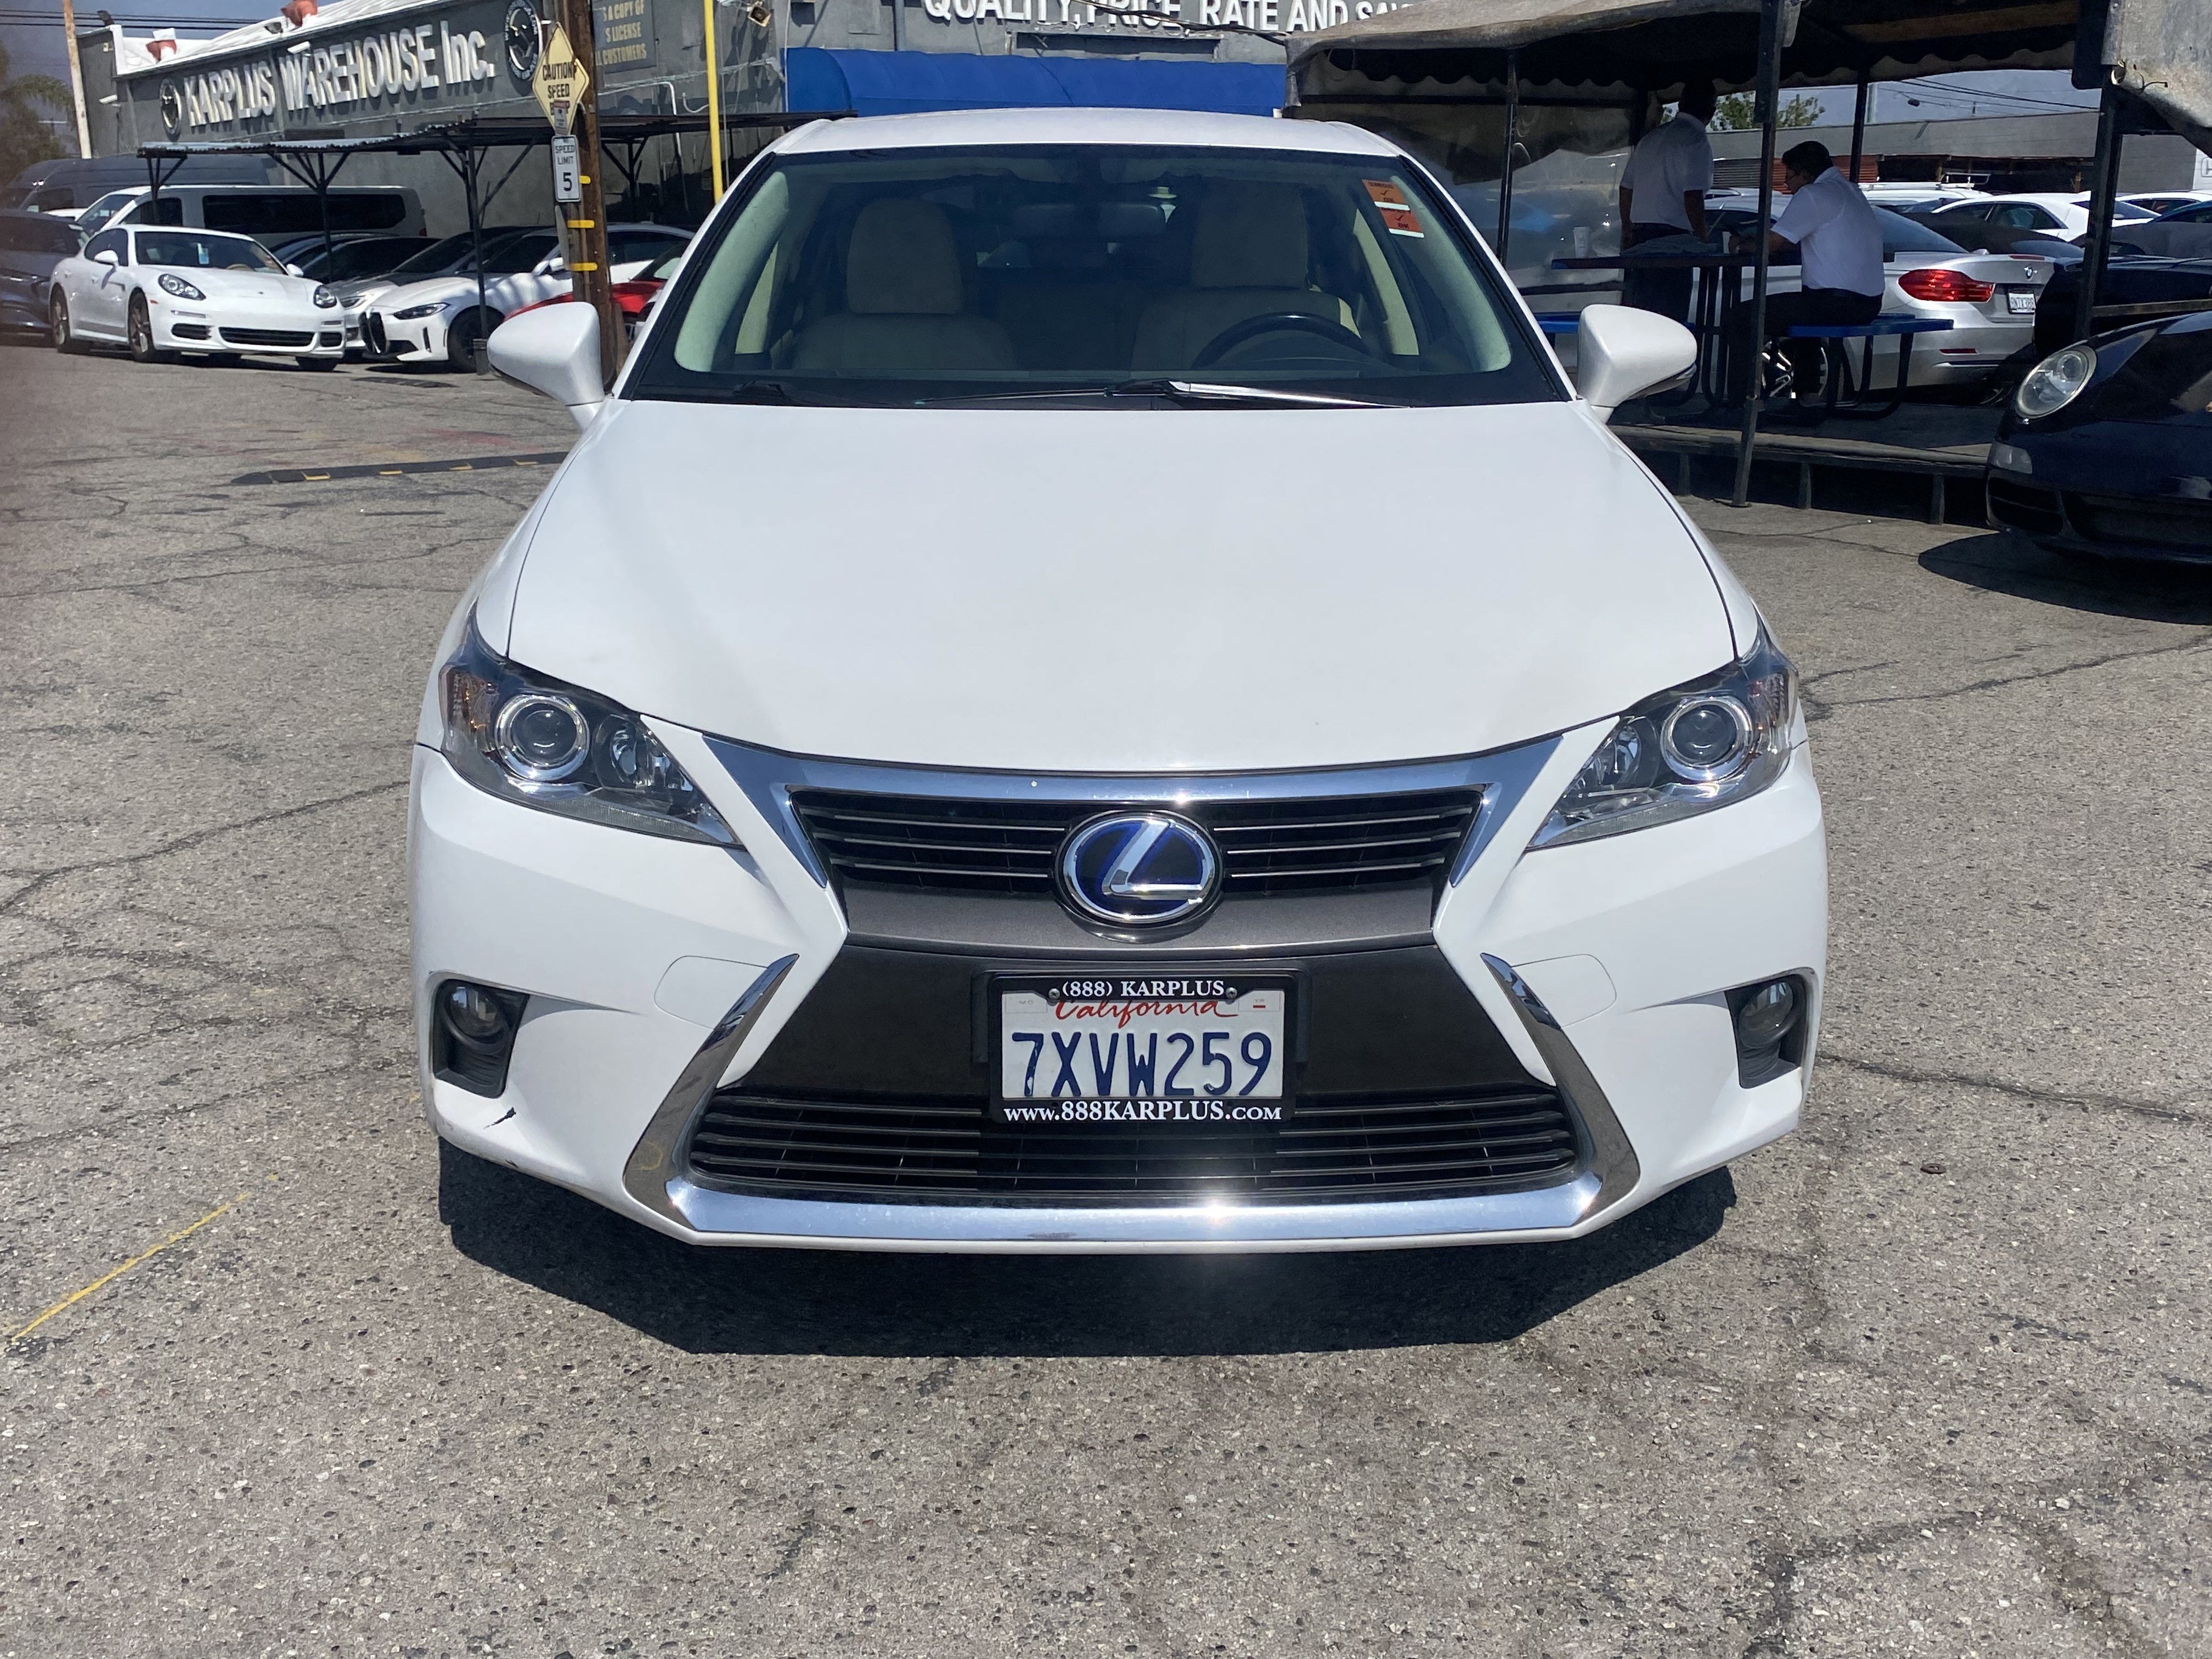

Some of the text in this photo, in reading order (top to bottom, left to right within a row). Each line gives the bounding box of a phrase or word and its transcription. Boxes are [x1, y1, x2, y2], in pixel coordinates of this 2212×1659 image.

[1200, 0, 1279, 31] RATE
[1286, 0, 1348, 32] AND
[612, 21, 641, 42] LICENSE
[602, 43, 647, 65] CUSTOMERS
[183, 60, 276, 127] KARPLUS
[279, 24, 439, 110] WAREHOUSE
[441, 20, 495, 84] Inc.
[548, 83, 570, 99] SPEED
[555, 144, 575, 154] SPEED
[557, 156, 574, 165] LIMIT
[562, 172, 572, 191] 5
[1062, 980, 1224, 997] (888) KARPLUS
[1055, 999, 1239, 1029] California
[1012, 1032, 1272, 1097] 7XVW259
